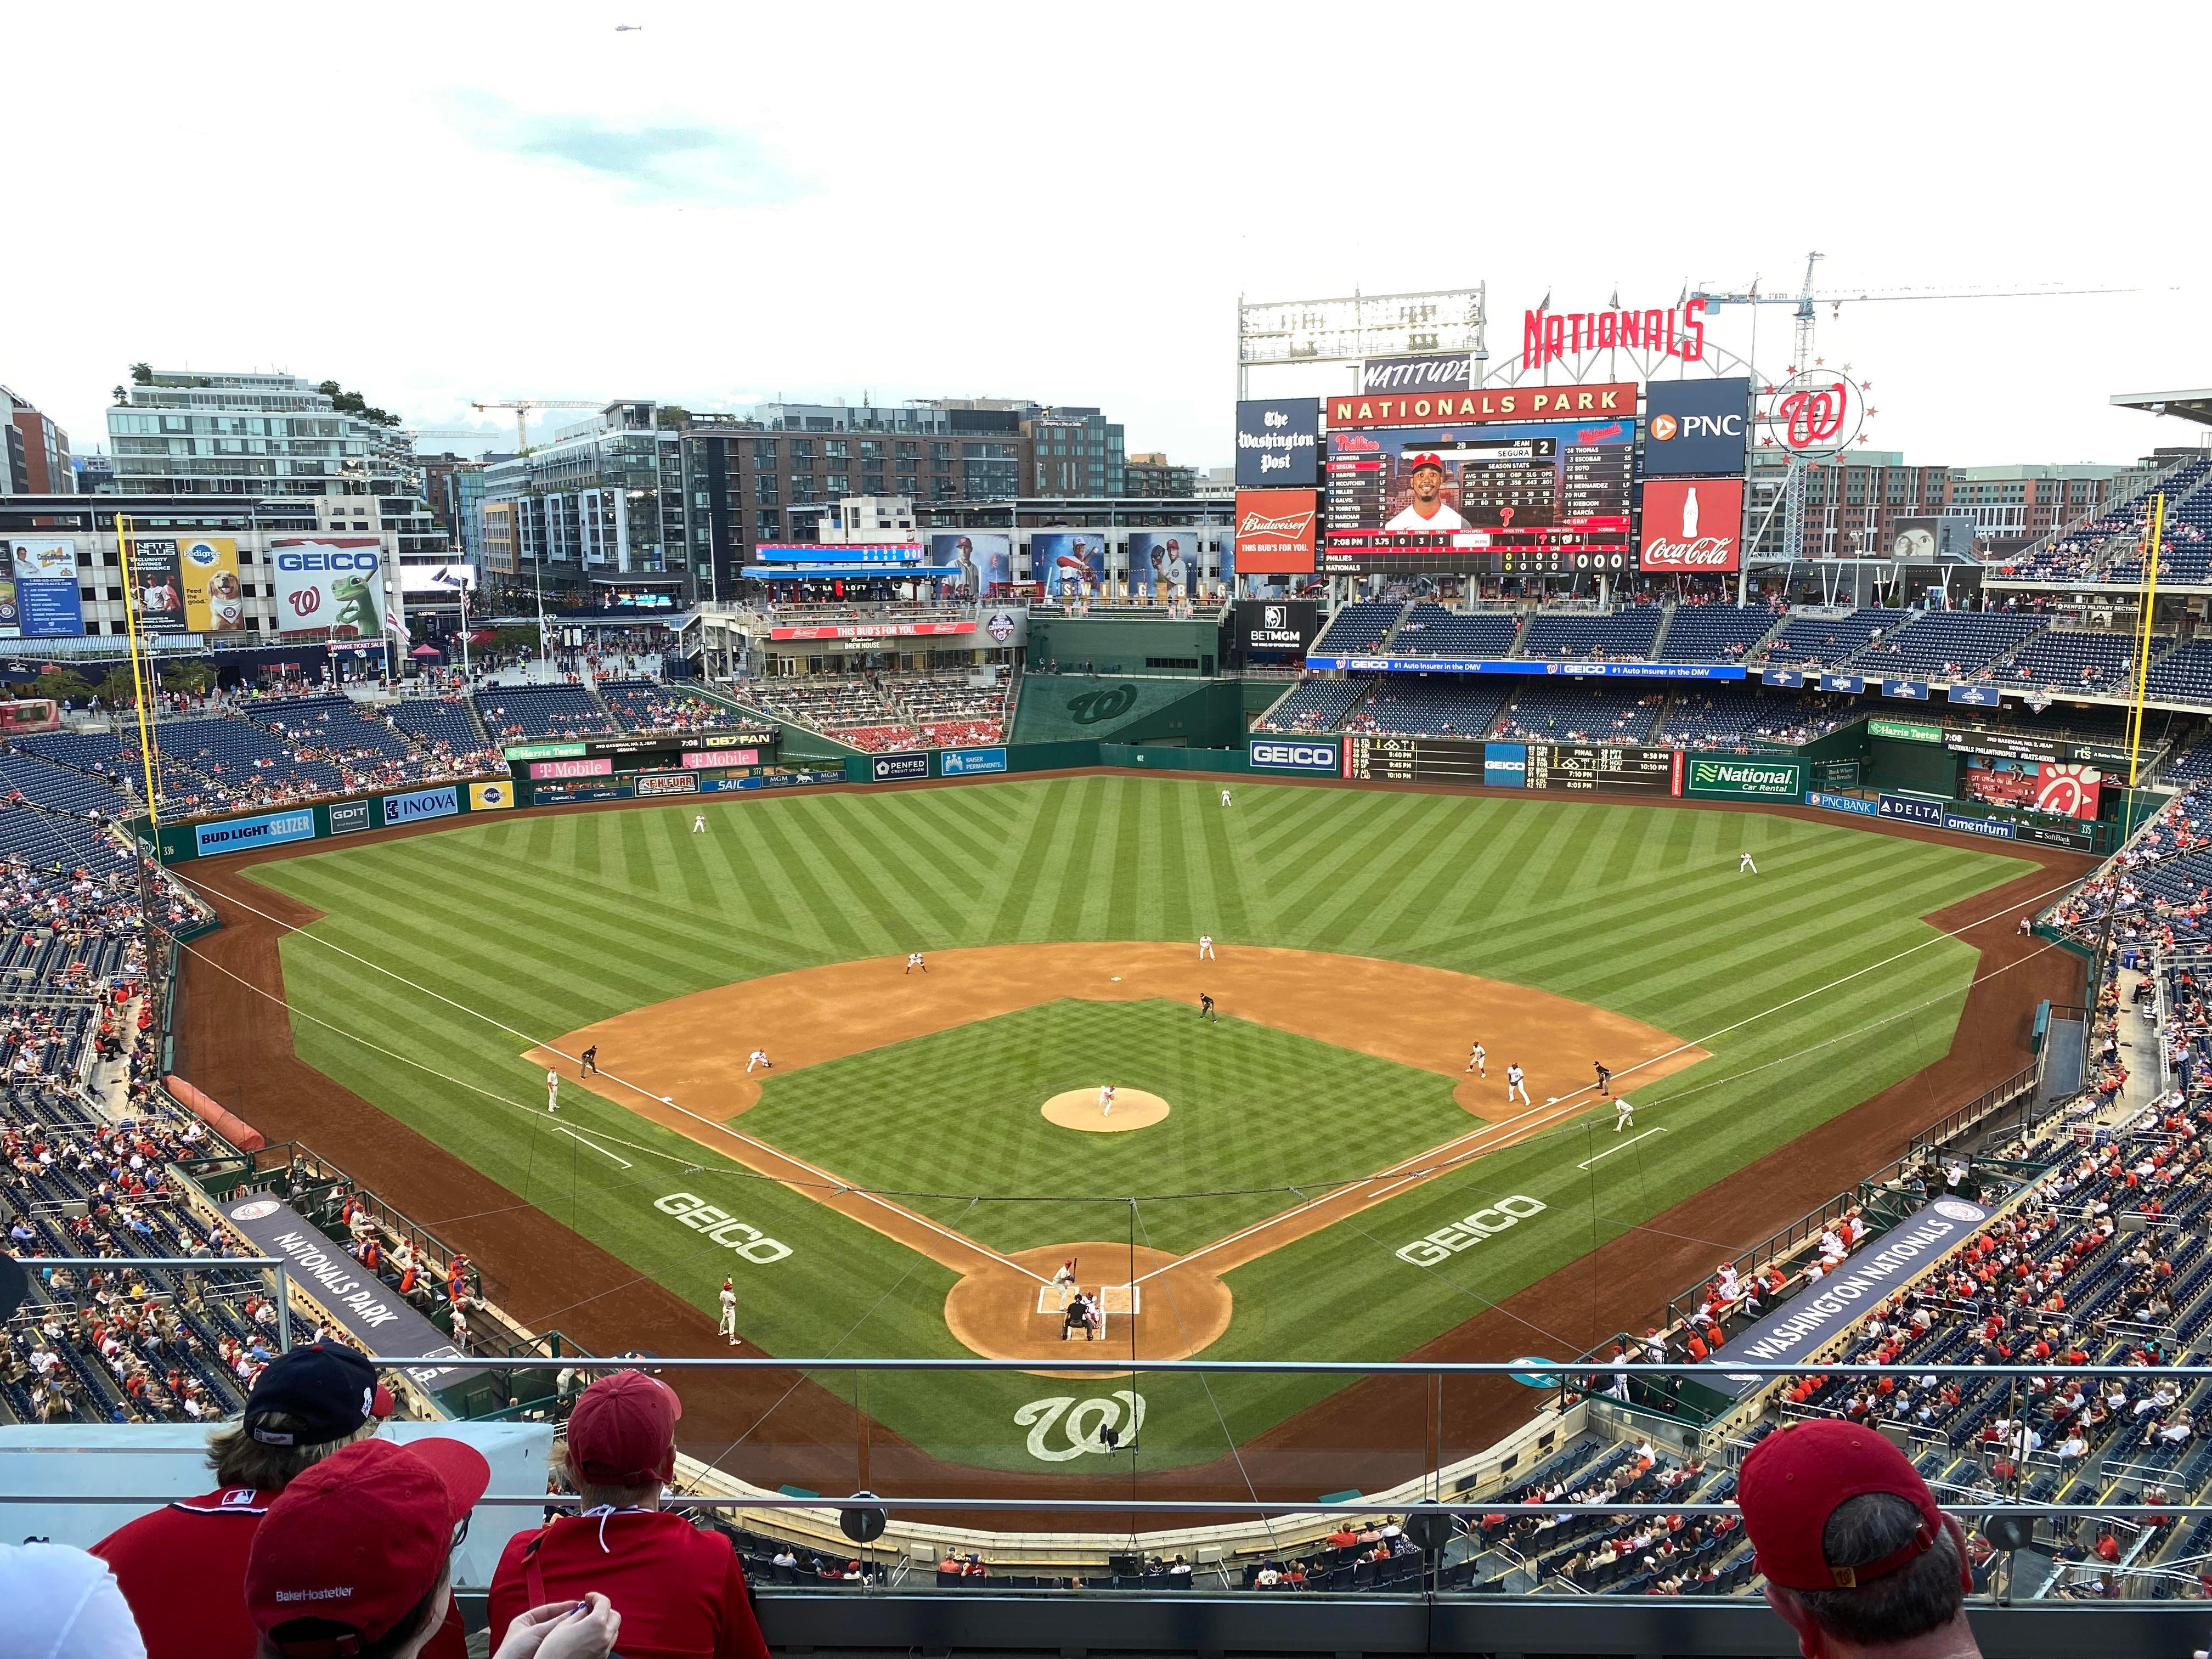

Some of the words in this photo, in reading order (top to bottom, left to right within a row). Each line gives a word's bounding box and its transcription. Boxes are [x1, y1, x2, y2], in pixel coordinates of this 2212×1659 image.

[1523, 298, 1706, 369] NATIONALS
[1364, 359, 1471, 388] NATITUDE
[1337, 395, 1515, 420] NATIONALS
[1534, 391, 1618, 411] PARK
[1264, 411, 1288, 428] The
[1681, 414, 1741, 437] PNC
[1238, 430, 1314, 450] Washington
[1335, 435, 1379, 451] Phillies
[1539, 441, 1548, 454] 2
[1261, 454, 1290, 473] Post
[1242, 517, 1306, 532] Budweiser
[1645, 537, 1735, 565] Coca-Cola
[279, 554, 378, 571] GEICO
[1577, 555, 1588, 568] 0
[1594, 554, 1605, 568] 0
[1611, 554, 1622, 568] 0
[837, 628, 856, 636] THIS
[857, 626, 880, 635] BUD'S
[882, 625, 897, 635] FOR
[899, 625, 916, 634] YOU.
[1251, 631, 1300, 641] BETMGM
[1351, 661, 1388, 669] GEICO
[1564, 665, 1606, 674] GEICO
[706, 737, 736, 746] 106.7
[741, 735, 769, 743] FAN
[1881, 726, 1909, 736] Harris
[1911, 729, 1939, 740] Teeter
[706, 751, 749, 764] Mobile
[1254, 746, 1333, 765] GEICO
[1948, 744, 1974, 752] NATIONALS
[1975, 747, 2016, 758] PHILANTHROPIES
[2074, 748, 2091, 760] rts
[554, 761, 602, 776] Mobile
[1485, 761, 1525, 771] GEICO
[718, 780, 744, 790] SAIC
[404, 794, 455, 814] INOVA
[1895, 802, 1940, 819] DELTA
[332, 807, 365, 820] GDIT
[202, 832, 229, 844] BUD
[232, 825, 268, 839] LIGHT
[270, 816, 309, 835] SELTZER
[1948, 818, 2009, 837] amentum
[2081, 823, 2091, 834] 335
[2044, 832, 2070, 843] SoftBank
[163, 846, 174, 855] 336
[653, 1193, 793, 1264] GEICO
[1396, 1195, 1547, 1267] GEICO
[273, 1231, 360, 1296] NATIONALS
[342, 1290, 399, 1328] PARK
[1743, 1274, 1876, 1360] WASHINGTON
[1856, 1219, 1955, 1281] NATIONALS
[276, 1585, 352, 1601] BakerHostetler
